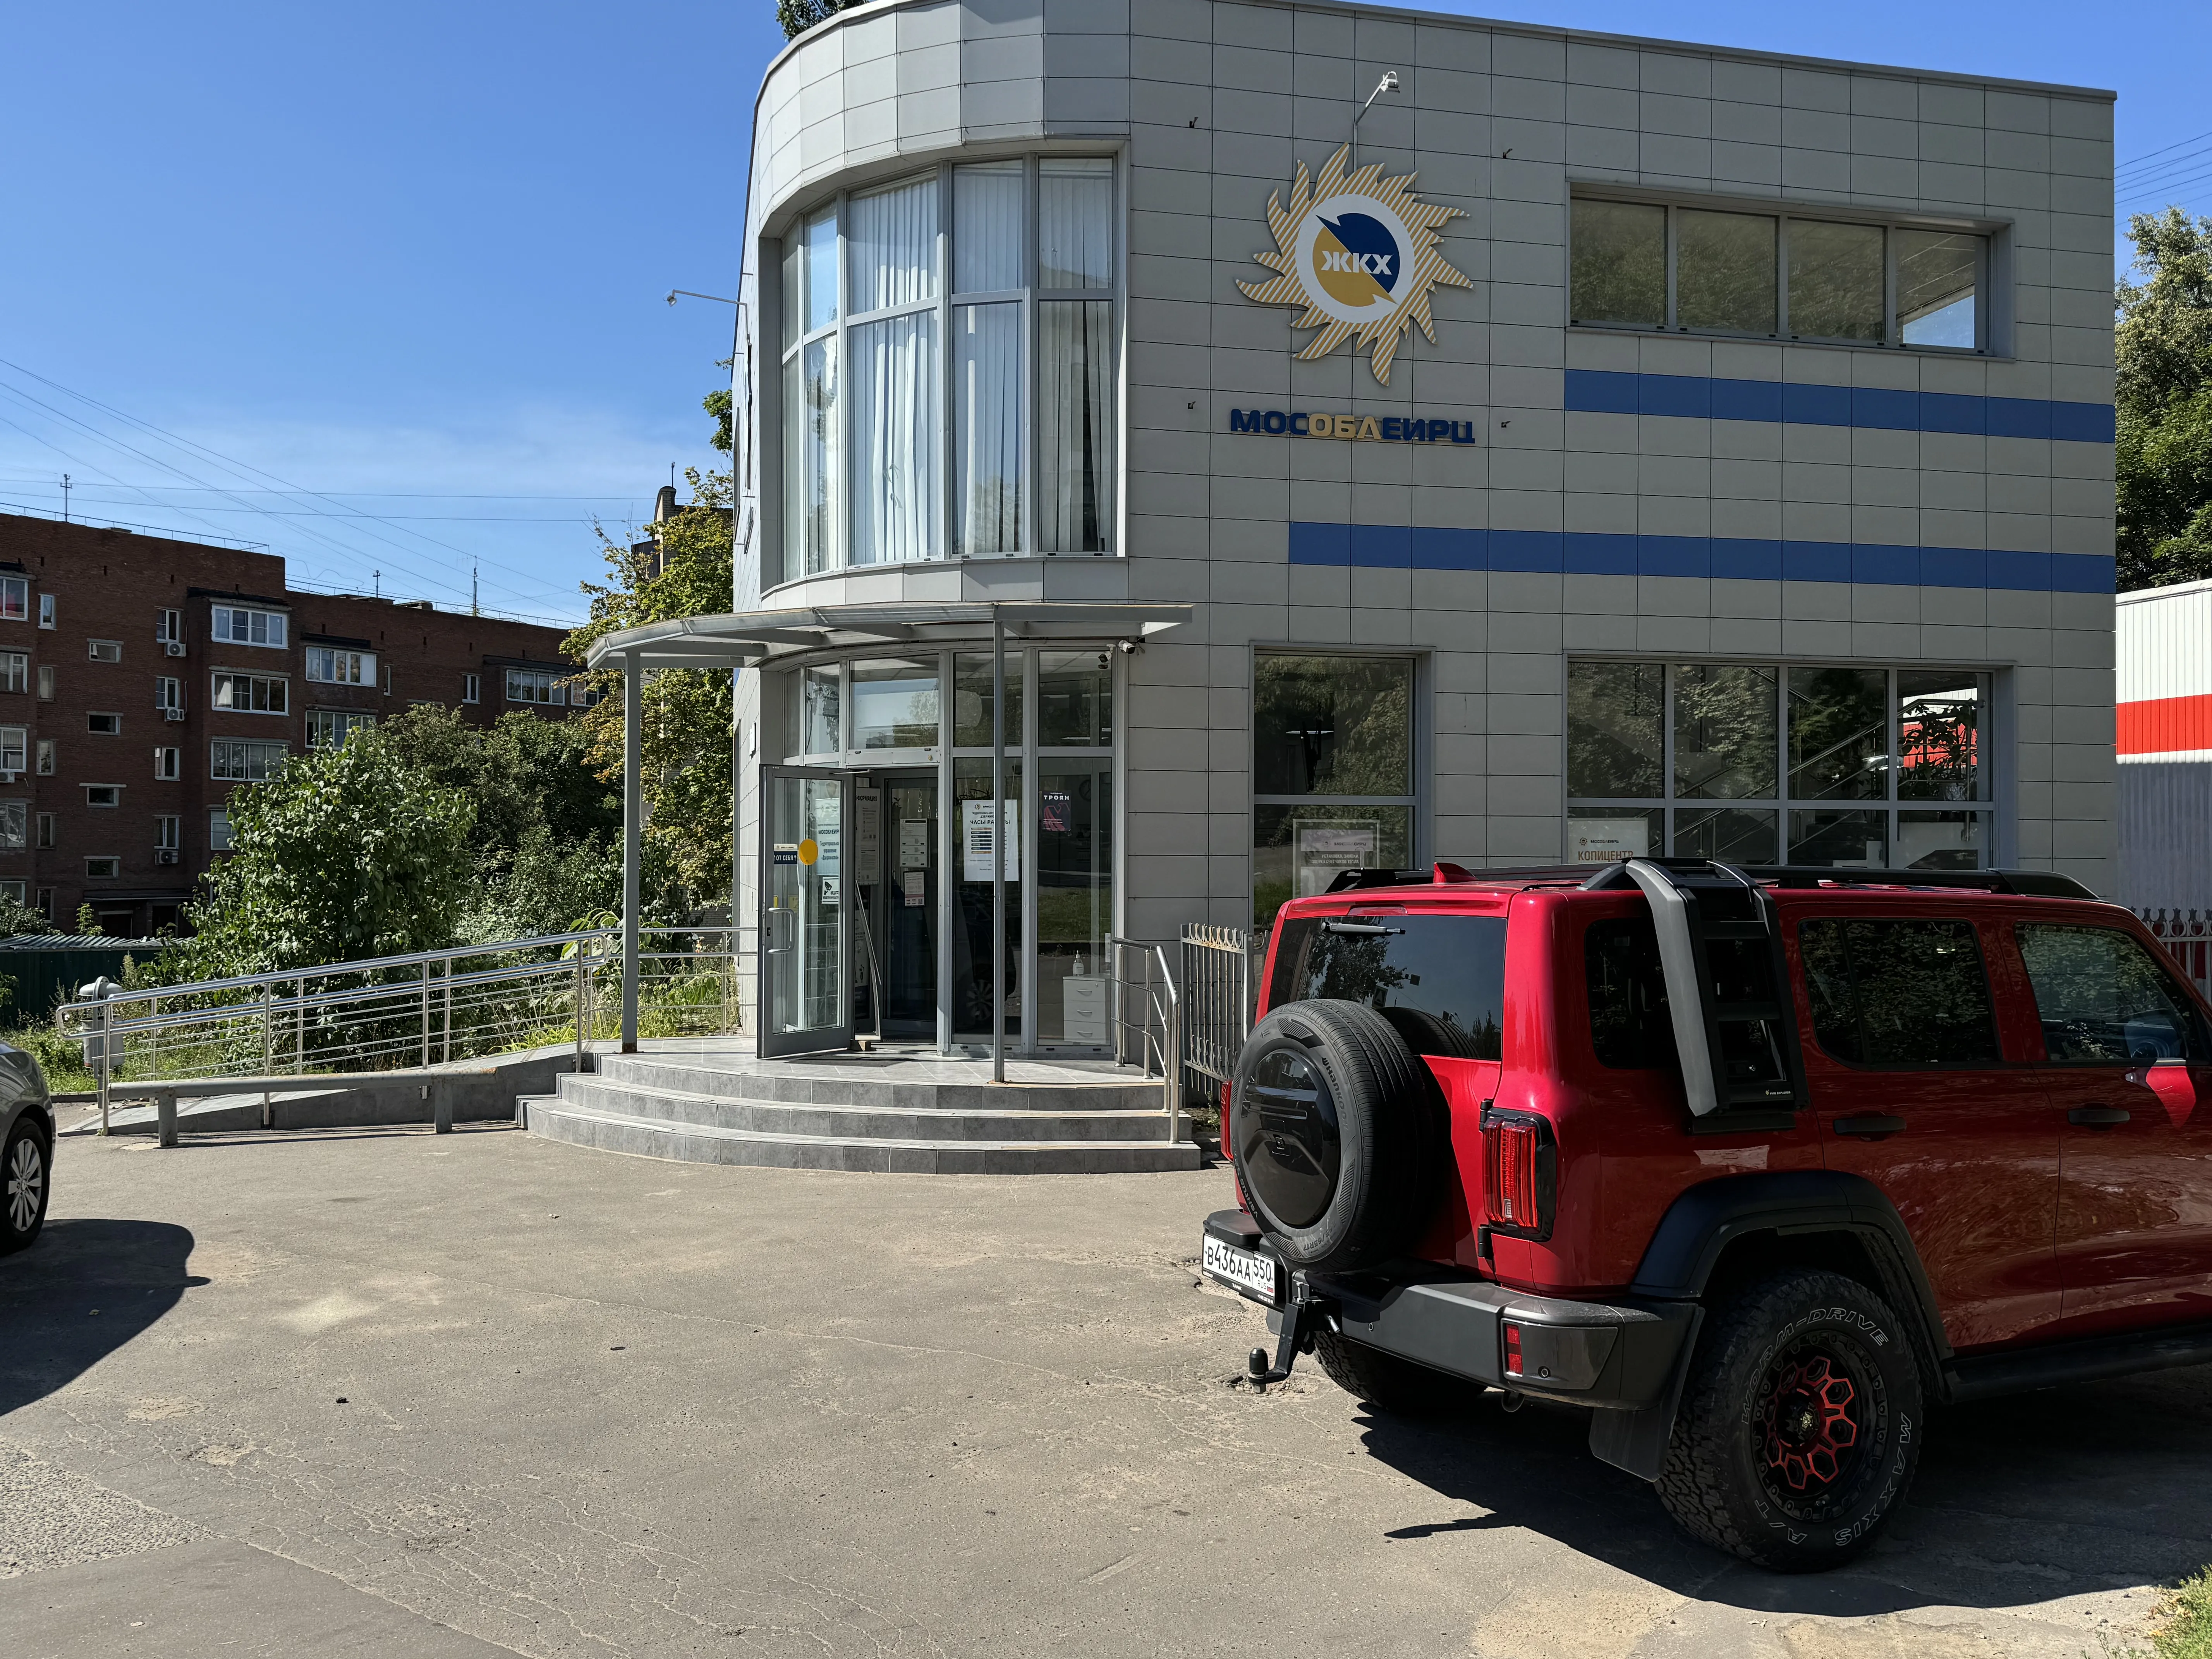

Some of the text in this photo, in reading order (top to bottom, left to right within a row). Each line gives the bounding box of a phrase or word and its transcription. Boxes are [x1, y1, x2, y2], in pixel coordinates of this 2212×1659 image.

[1321, 251, 1393, 275] ЖКХ
[1231, 409, 1475, 444] МОСОБЛЕИРЦ
[1578, 850, 1633, 862] КОПИЦЕНТР
[1258, 1280, 1267, 1290] RUS
[1740, 1307, 1889, 1425] WORM-DRIVE
[1834, 1412, 1912, 1546] MAXXIS
